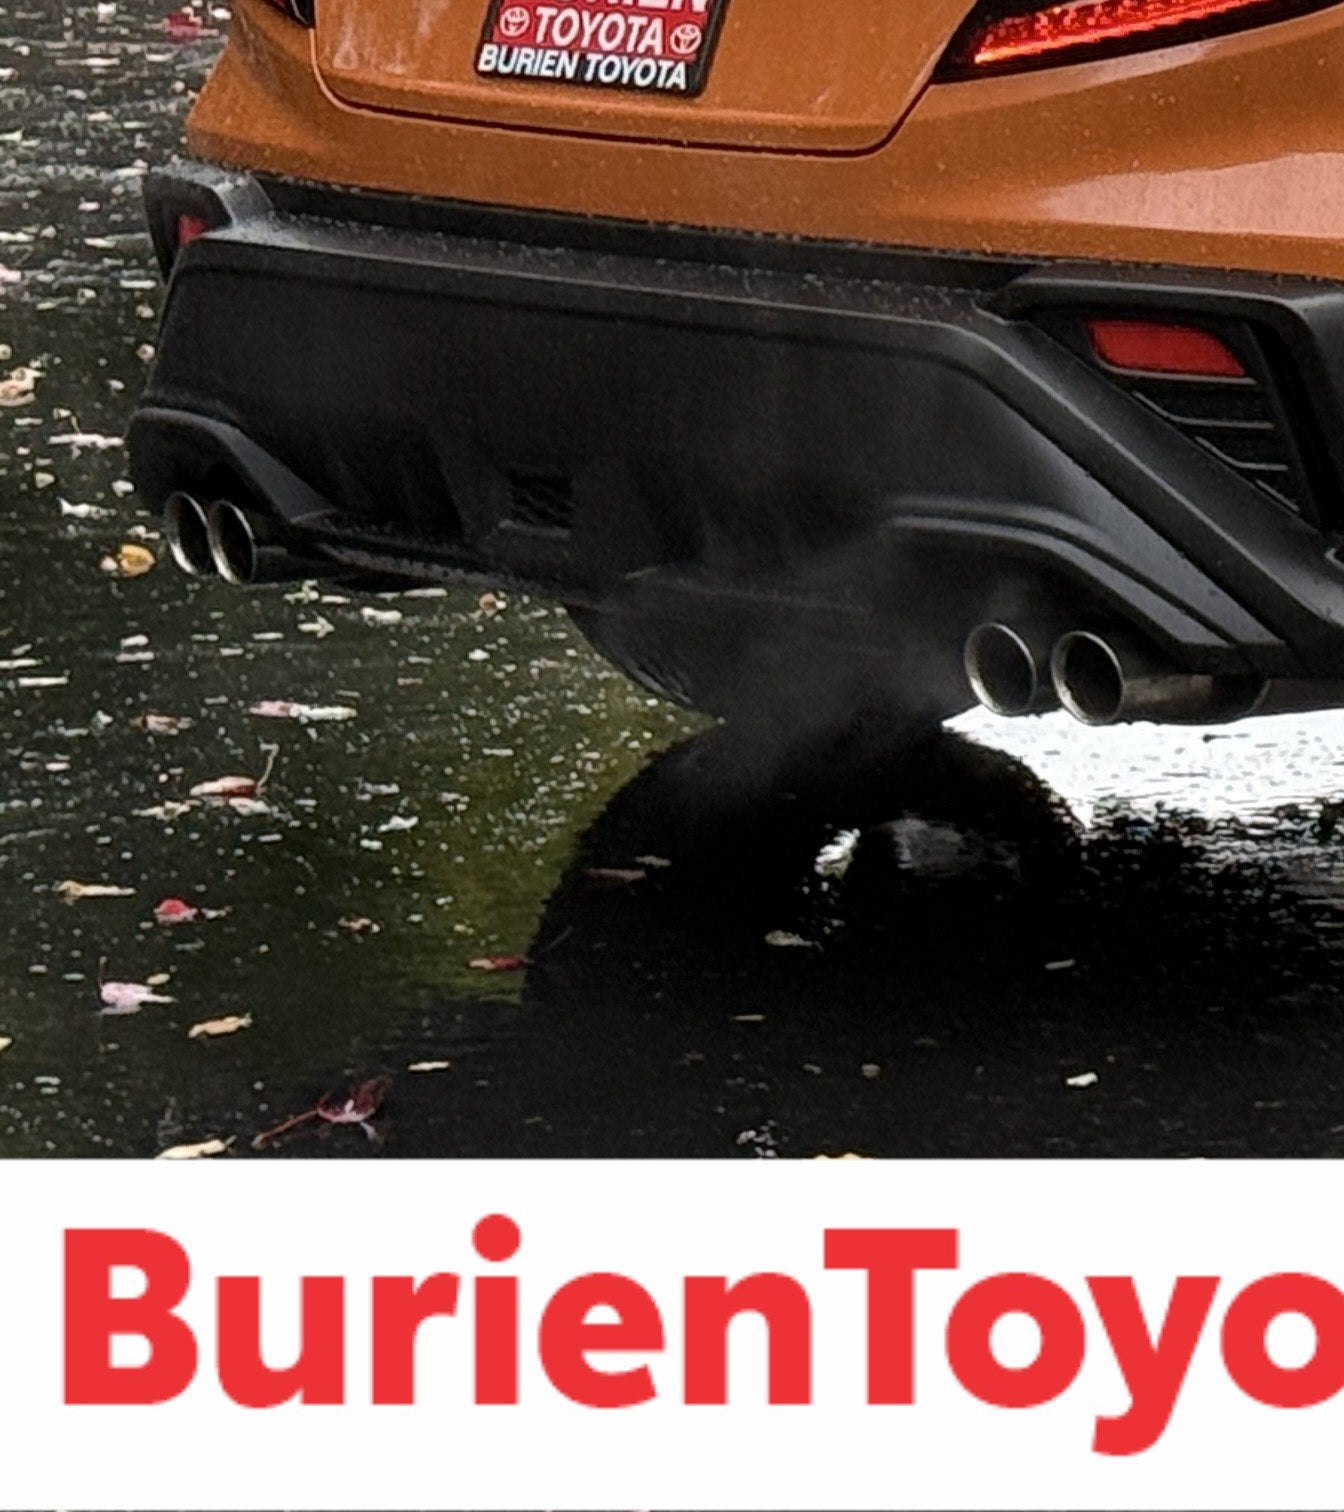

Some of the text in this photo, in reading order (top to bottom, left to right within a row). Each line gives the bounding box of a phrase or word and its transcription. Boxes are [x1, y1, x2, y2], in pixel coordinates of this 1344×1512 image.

[534, 5, 665, 56] TOYOTA
[477, 43, 688, 91] BURIEN TOYOTA
